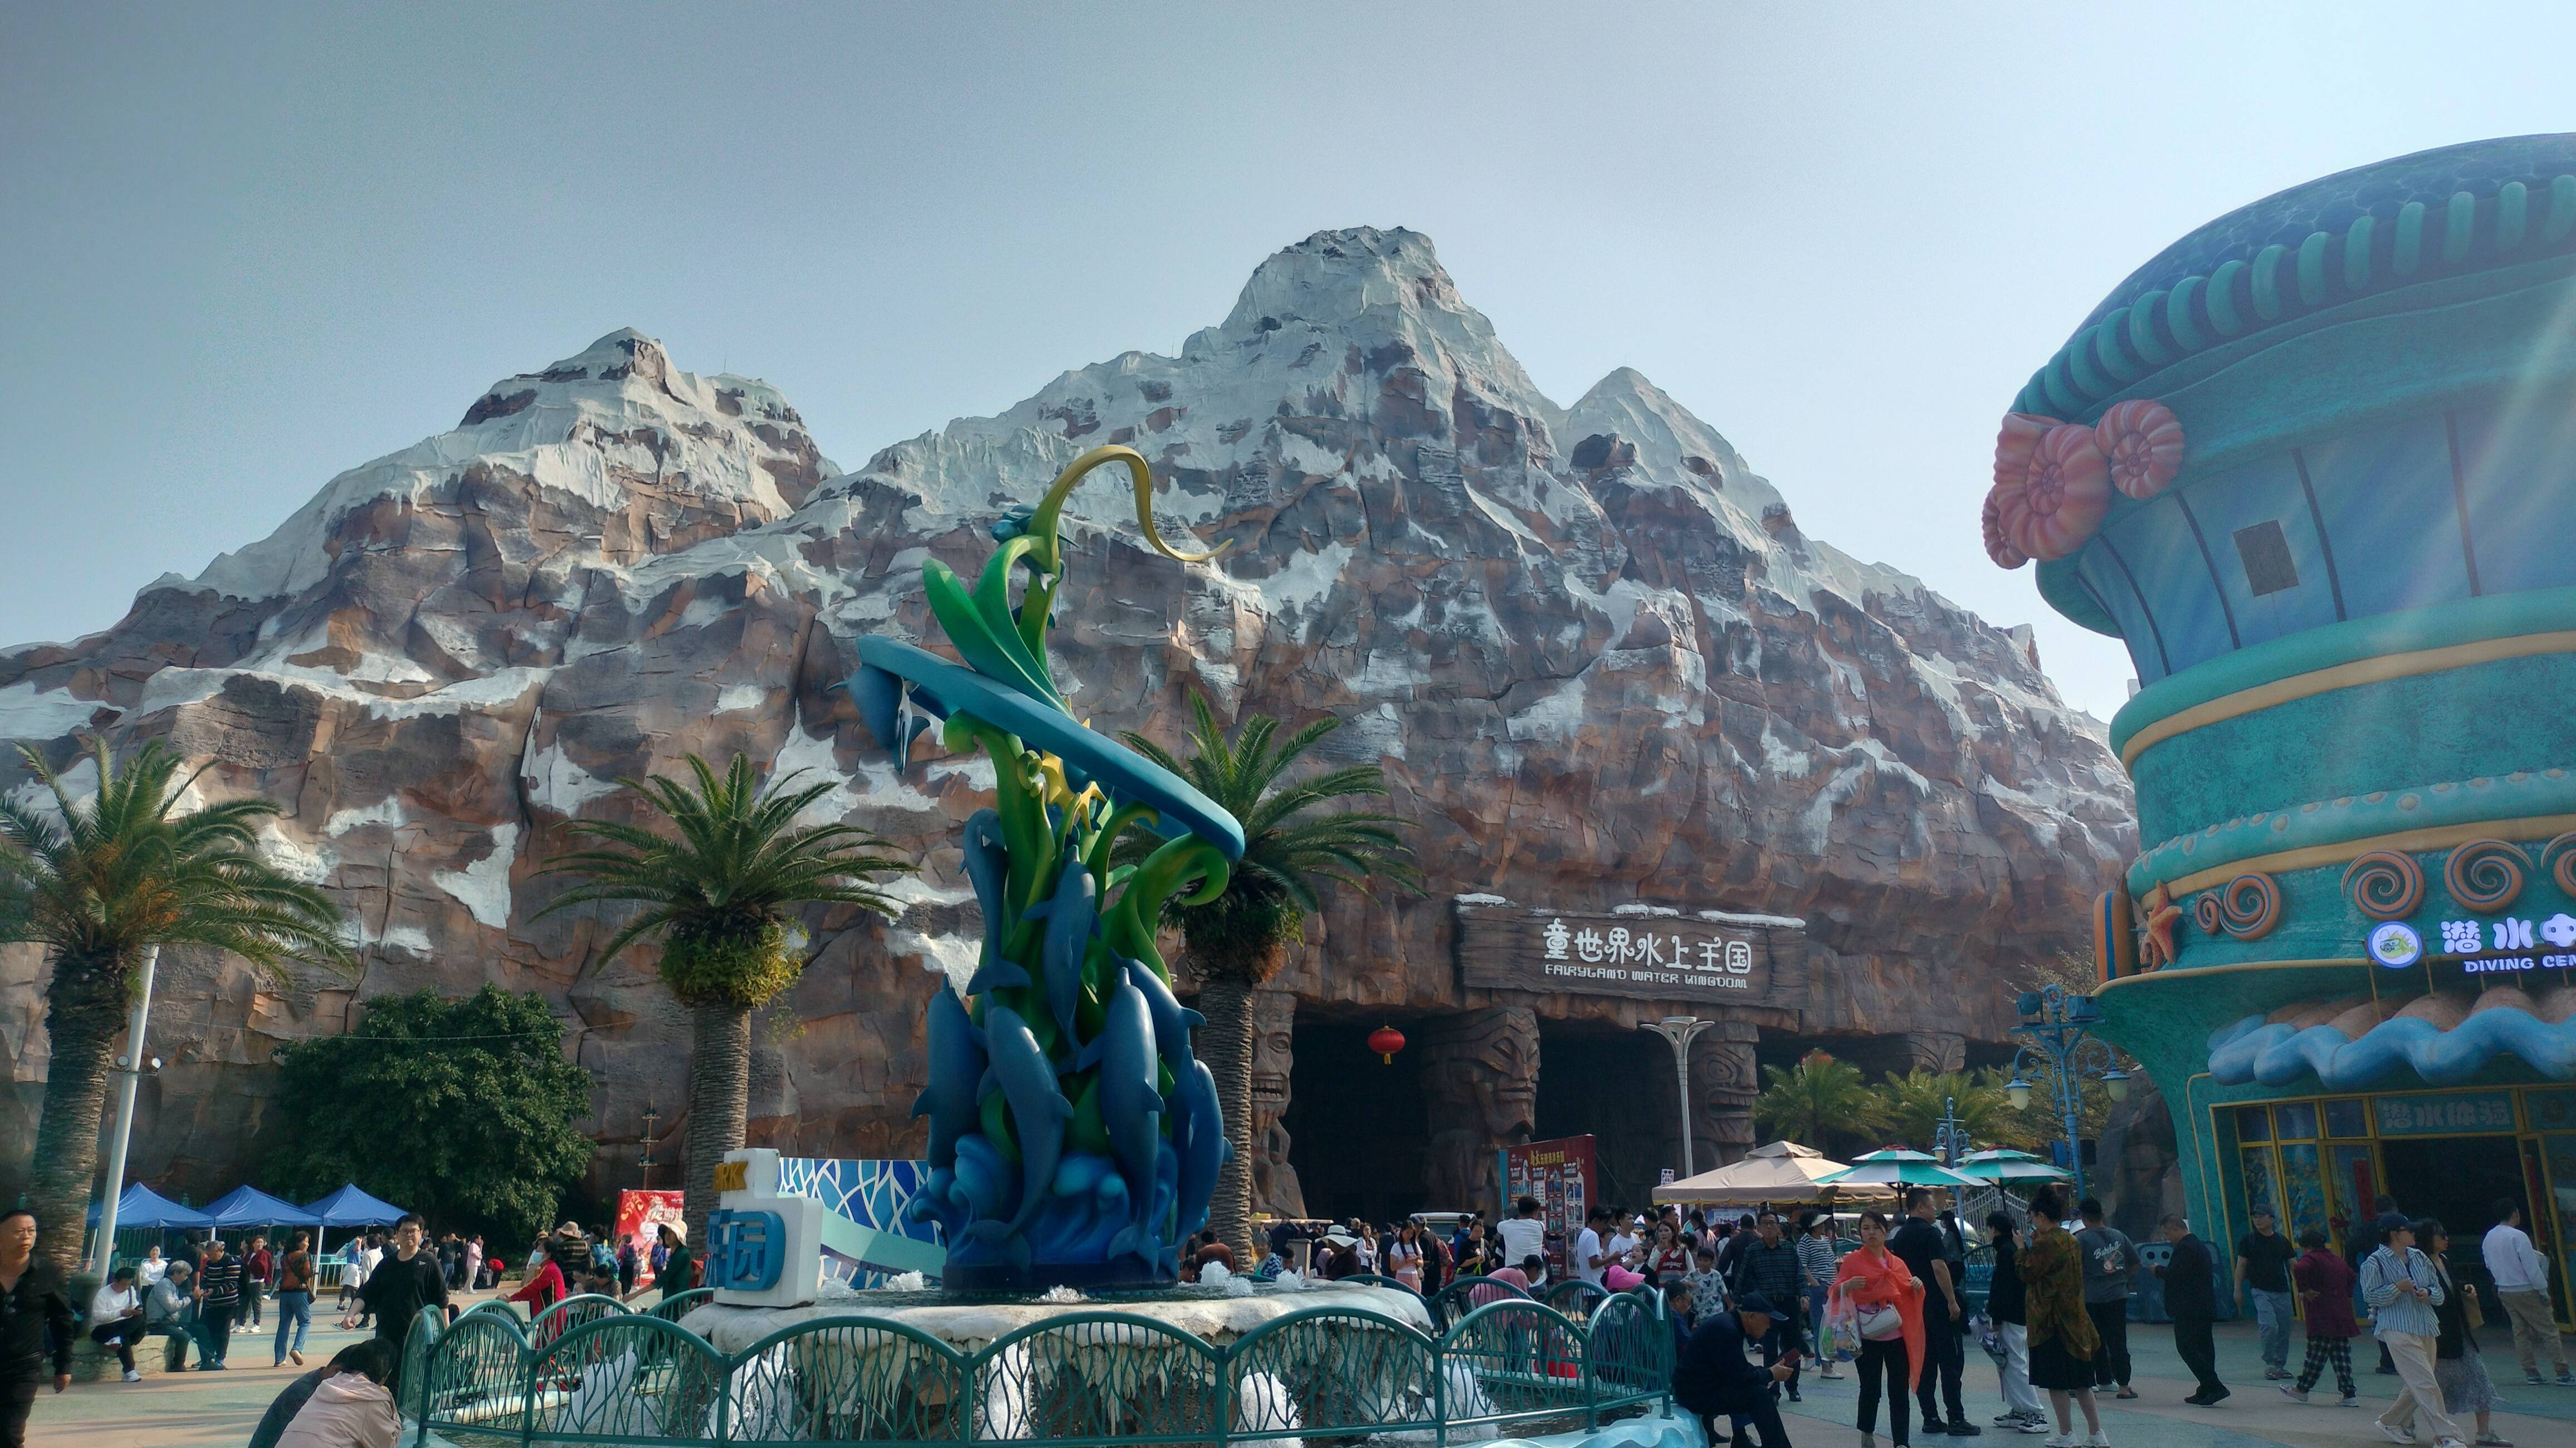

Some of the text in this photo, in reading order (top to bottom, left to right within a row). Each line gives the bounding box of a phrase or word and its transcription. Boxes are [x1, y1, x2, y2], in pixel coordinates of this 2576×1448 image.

[1542, 917, 1752, 974] 童世界水上王国
[1545, 964, 1748, 989] FAIRYLAND WATER KINGDOM
[2465, 957, 2534, 972] DIVING
[2383, 1100, 2510, 1129] 潜水体验
